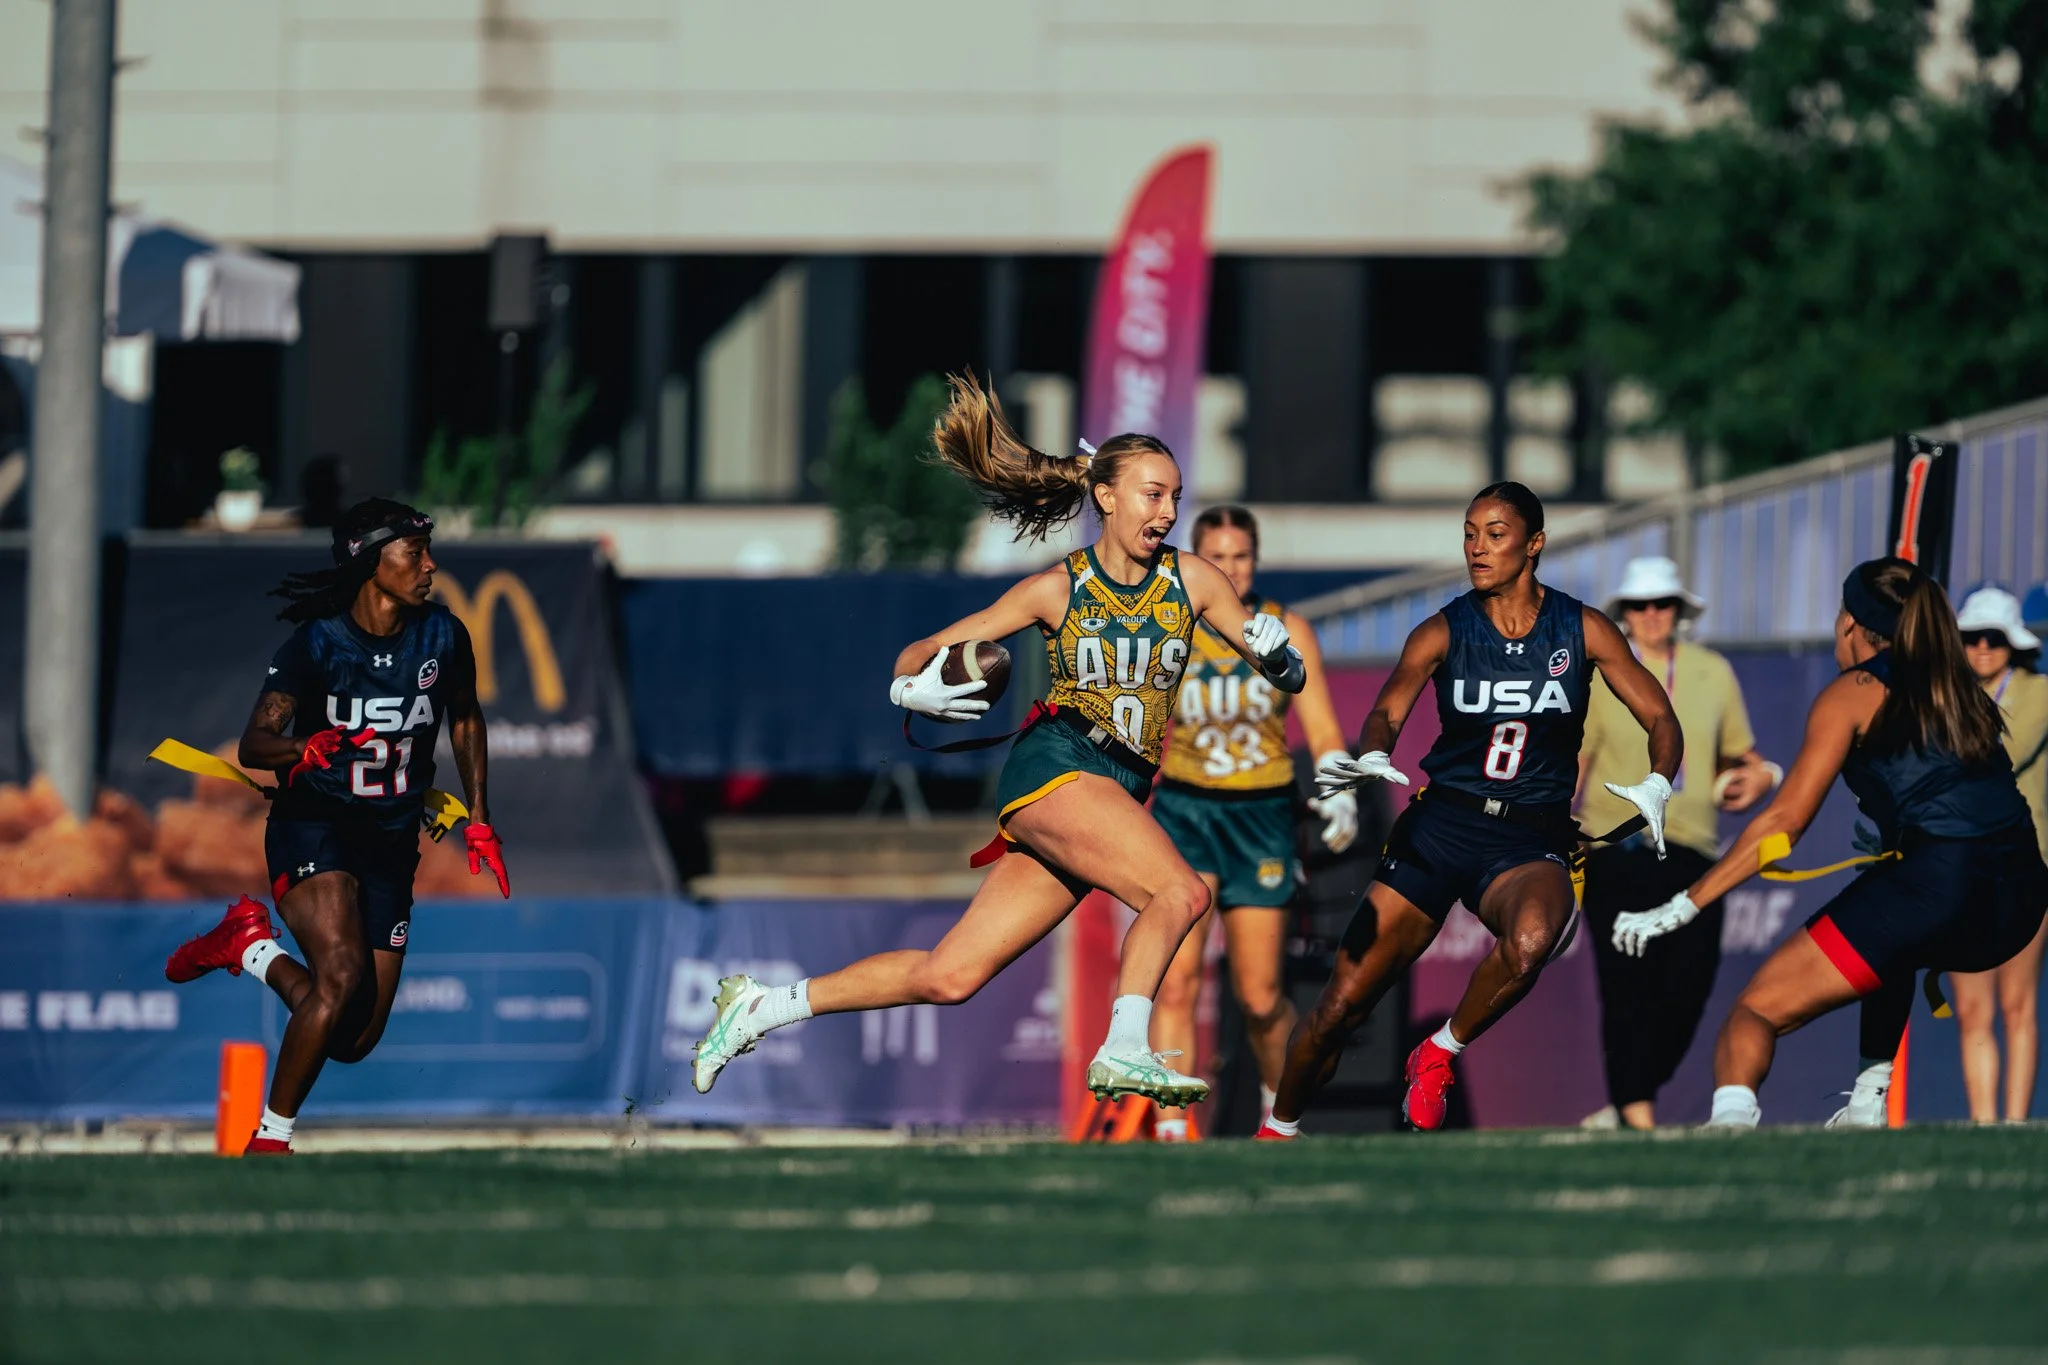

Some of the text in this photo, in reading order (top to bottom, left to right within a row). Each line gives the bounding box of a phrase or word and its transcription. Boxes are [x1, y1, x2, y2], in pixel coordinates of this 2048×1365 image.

[1080, 605, 1108, 620] AFA
[1115, 616, 1148, 624] VALOUR
[1076, 637, 1187, 690] AUS
[326, 694, 435, 732] USA
[1181, 674, 1273, 725] AUS
[1453, 679, 1572, 714] USA
[350, 736, 414, 798] 21
[1484, 720, 1529, 781] 8
[38, 990, 180, 1030] FLAG
